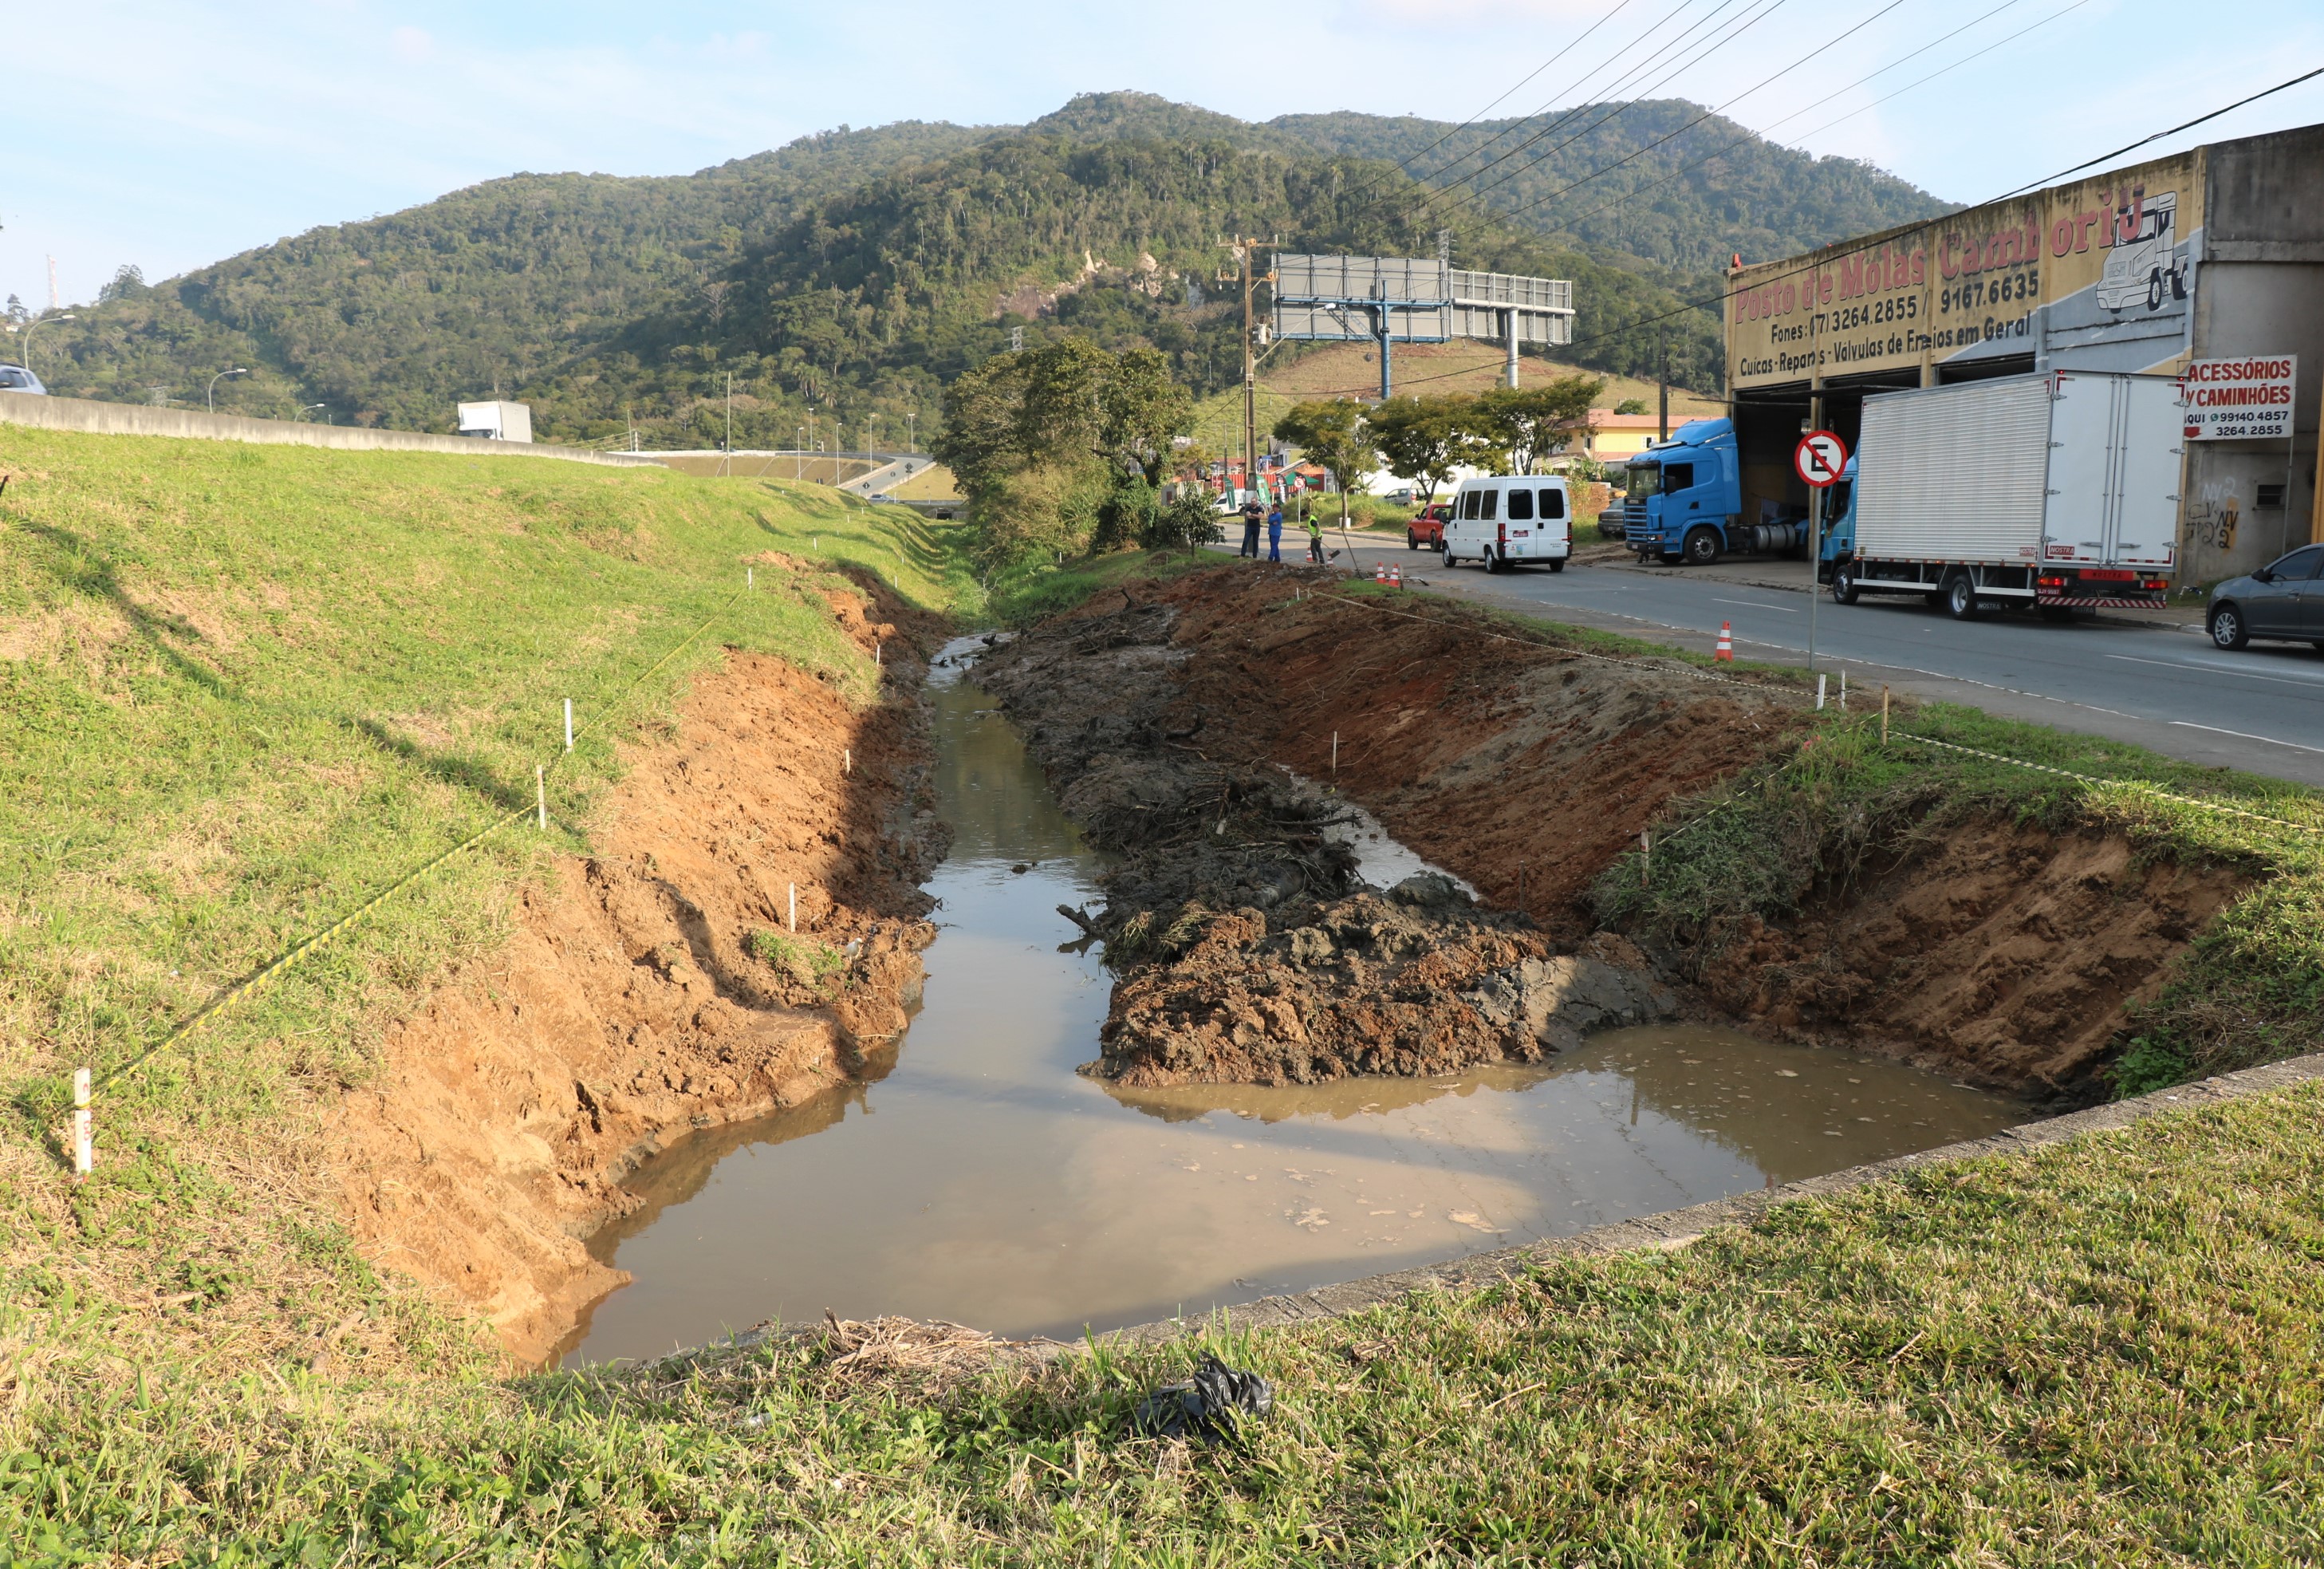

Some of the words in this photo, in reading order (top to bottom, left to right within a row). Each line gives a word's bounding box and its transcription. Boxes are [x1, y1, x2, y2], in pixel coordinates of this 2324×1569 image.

[1736, 278, 1796, 324] Posto
[1802, 267, 1834, 311] de
[1838, 244, 1924, 302] Molas
[1832, 295, 1916, 333] 3264.2855
[1940, 270, 2038, 314] 9167.6635
[1834, 337, 1883, 362] Válvulas
[1887, 332, 1903, 353] de
[1956, 327, 1979, 346] em
[1983, 309, 2031, 341] Geral
[2188, 357, 2291, 383] ACESSÓRIOS
[2196, 383, 2291, 407] CAMINHÕES
[2220, 411, 2289, 422] 99140.4857
[2216, 425, 2283, 436] 3264.2855
[1811, 443, 1829, 471] E
